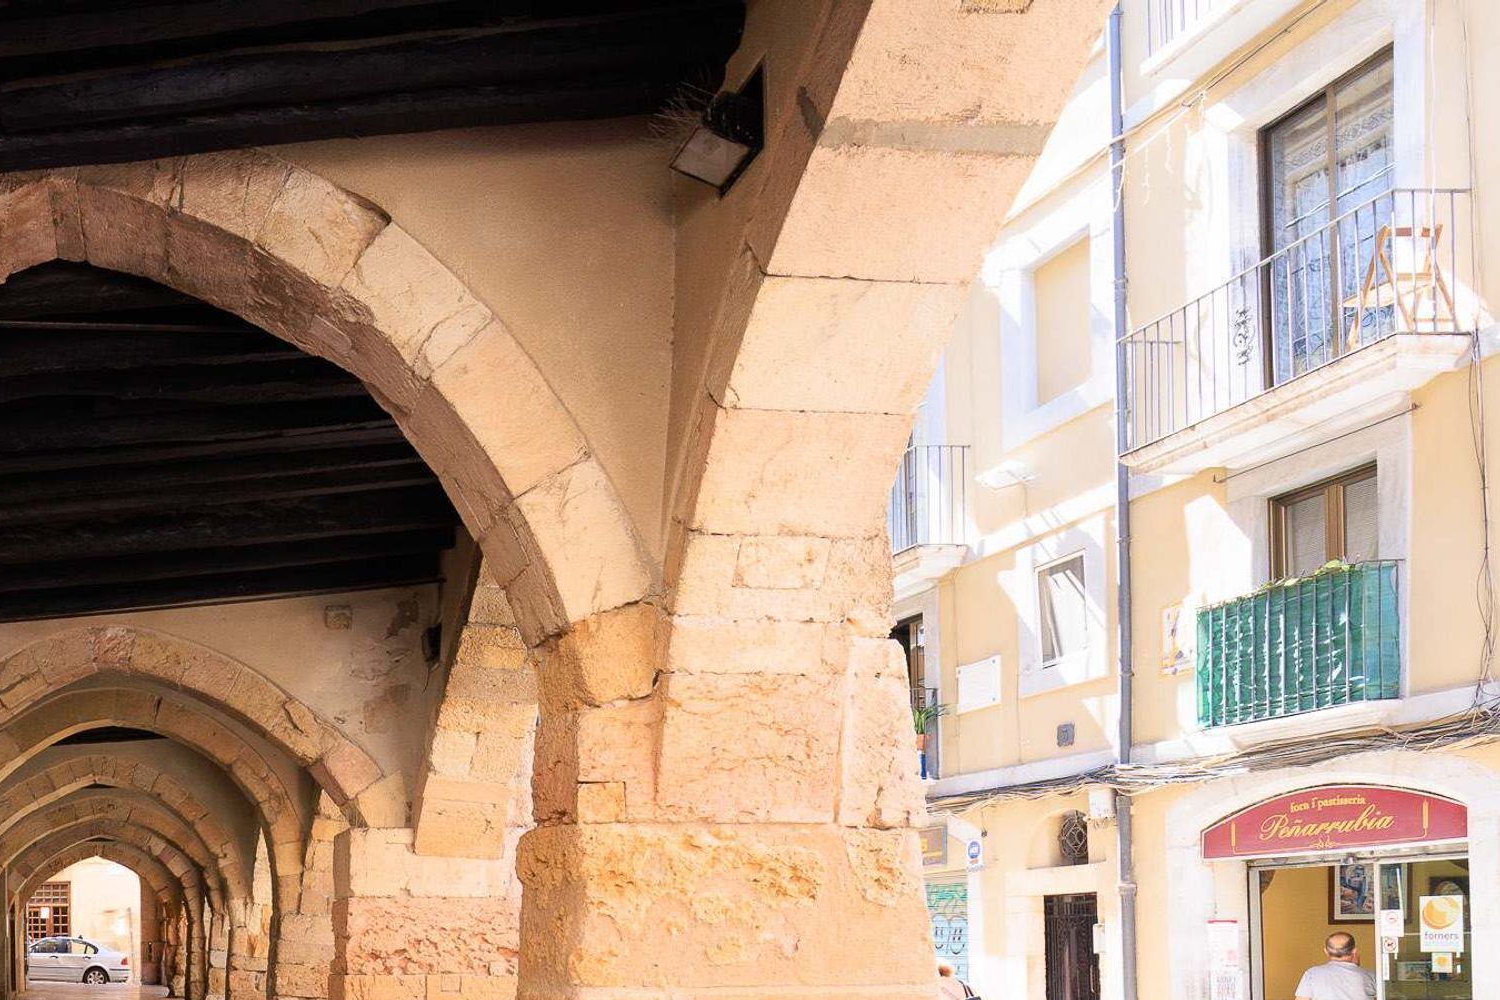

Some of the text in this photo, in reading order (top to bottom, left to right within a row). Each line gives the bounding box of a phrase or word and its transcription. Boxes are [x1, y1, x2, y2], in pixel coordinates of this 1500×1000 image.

[1290, 802, 1309, 813] forn
[1317, 794, 1367, 811] pastisseria
[1258, 804, 1395, 841] Peñarrubia
[1424, 931, 1459, 941] forners
